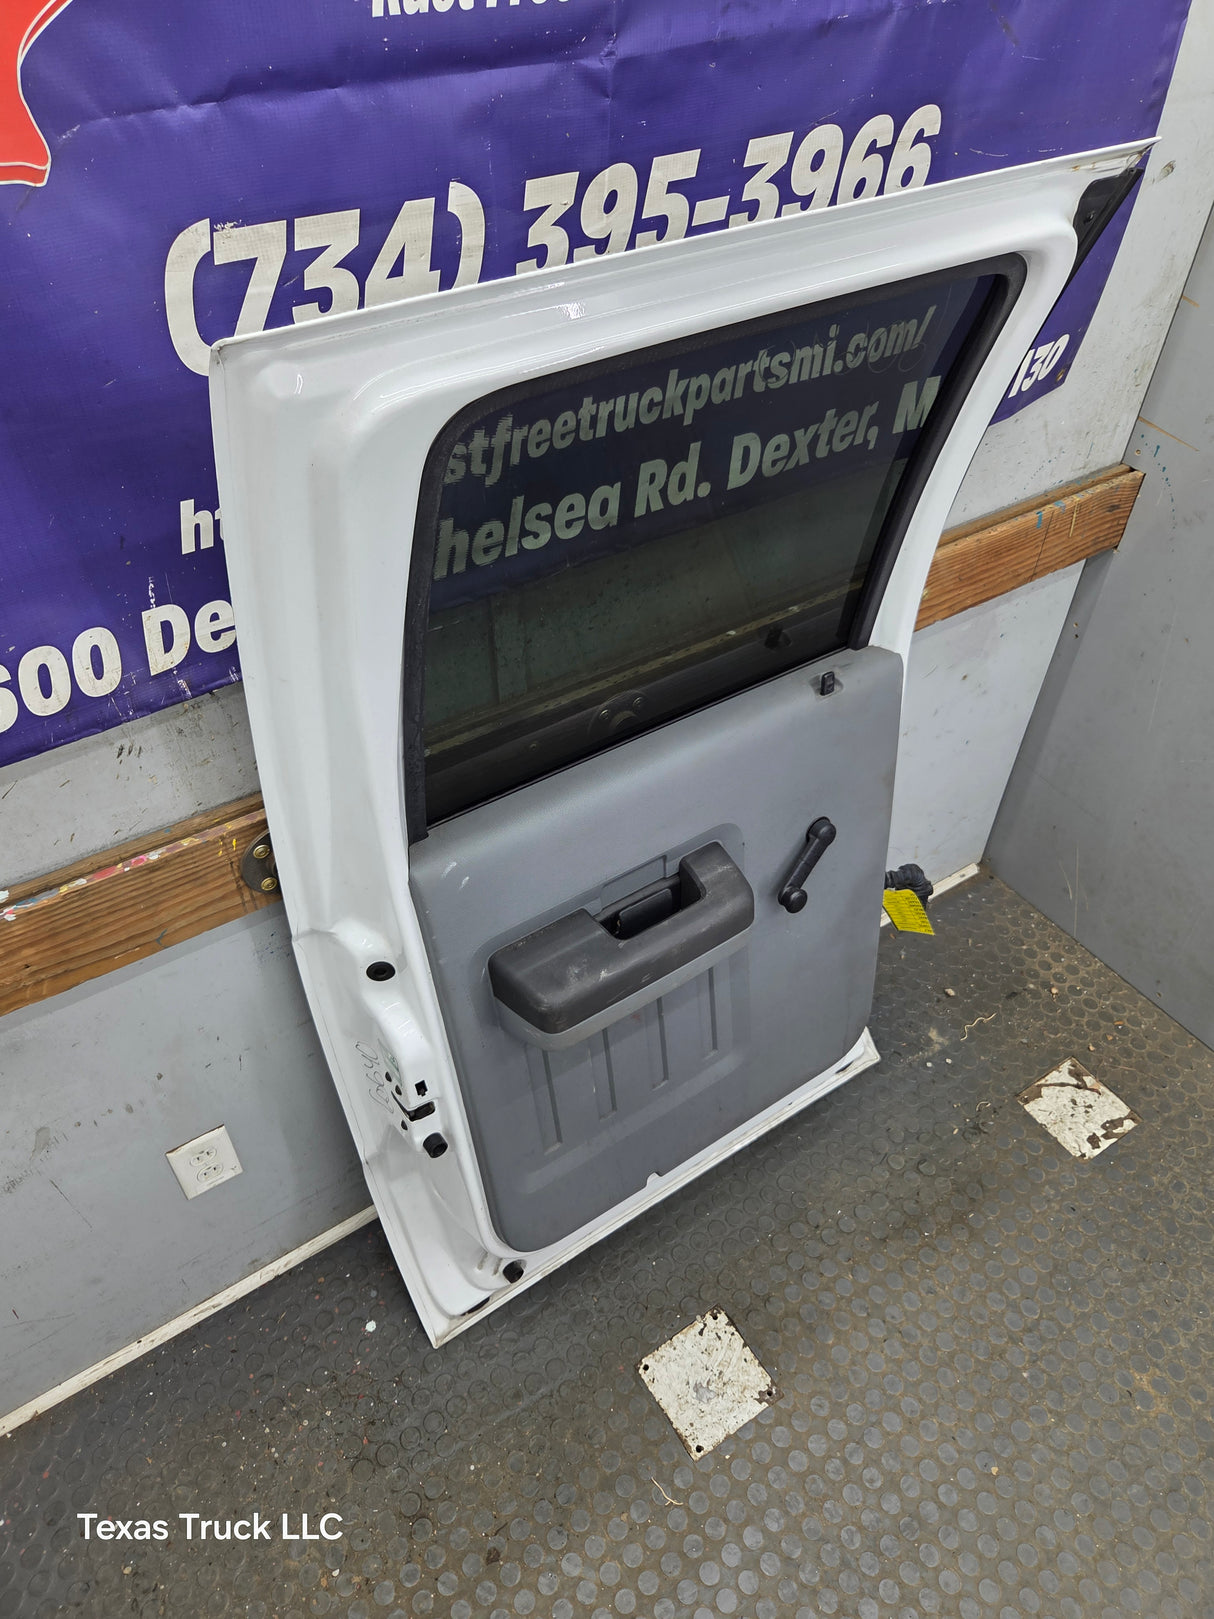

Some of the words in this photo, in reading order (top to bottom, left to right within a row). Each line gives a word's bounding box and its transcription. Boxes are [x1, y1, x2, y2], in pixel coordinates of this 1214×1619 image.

[164, 181, 486, 376] (734)
[515, 104, 942, 275] 395-3966
[433, 481, 622, 581] helsea
[634, 441, 712, 518] Rd.
[727, 401, 879, 491] Dexter,
